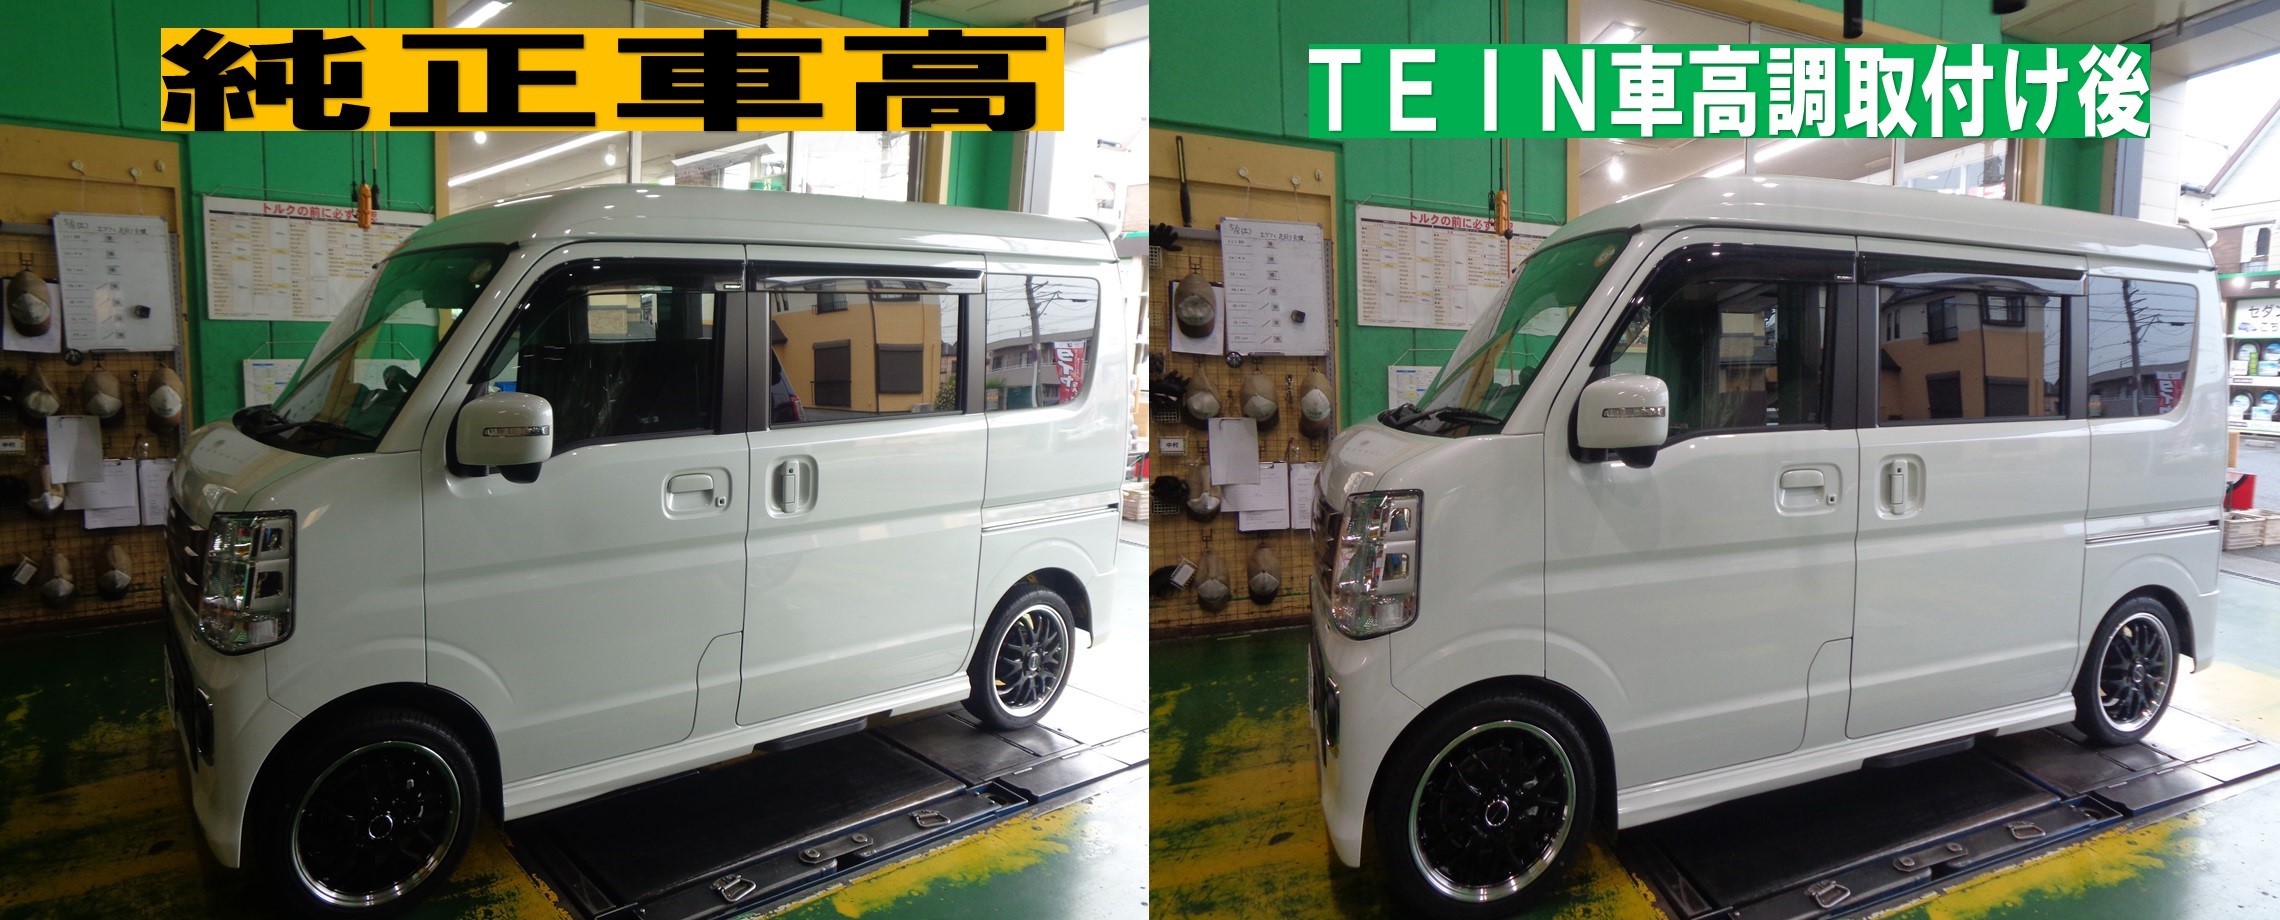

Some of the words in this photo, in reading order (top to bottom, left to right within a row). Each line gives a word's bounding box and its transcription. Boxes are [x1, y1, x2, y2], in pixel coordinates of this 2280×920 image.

[262, 202, 378, 221] トルクの前に必ず
[1409, 211, 1514, 231] トルクの前に必ず
